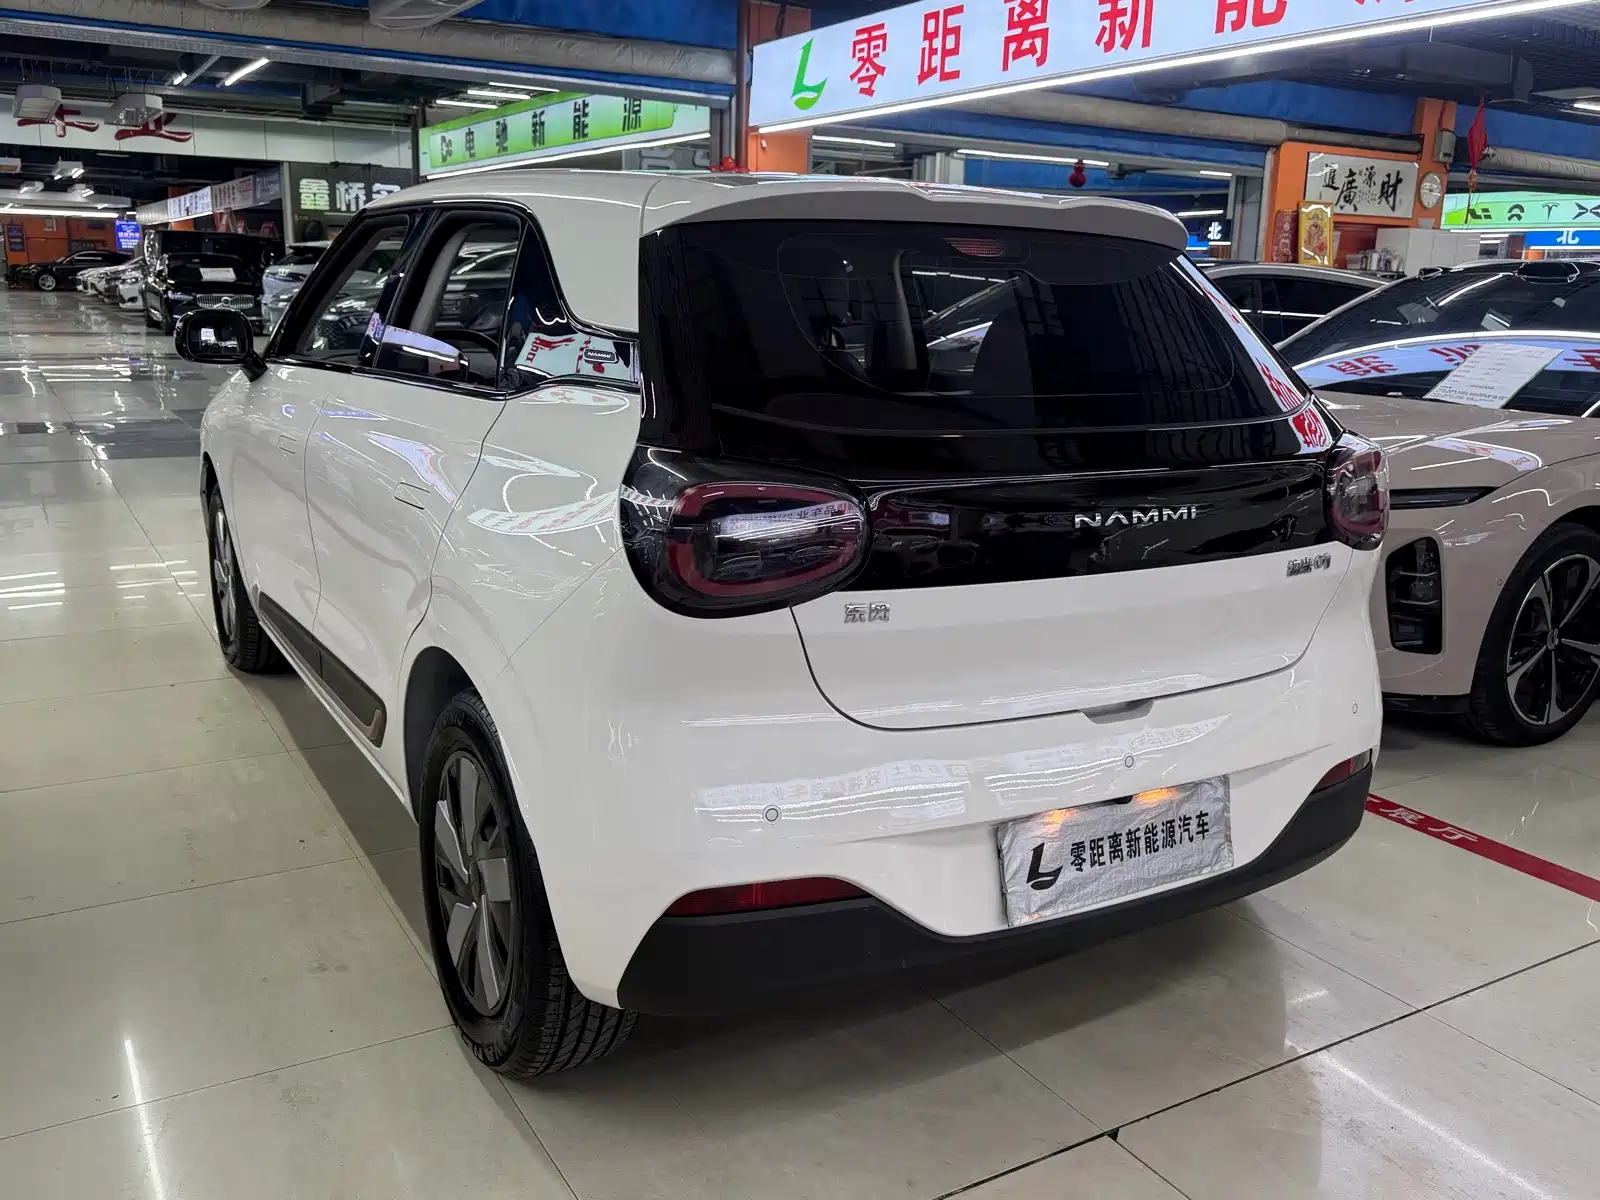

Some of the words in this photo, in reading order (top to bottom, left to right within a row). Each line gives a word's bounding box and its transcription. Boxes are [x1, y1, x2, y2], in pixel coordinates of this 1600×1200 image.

[849, 0, 1413, 97] 零距离新
[464, 97, 642, 158] 电驰新能源
[1074, 505, 1197, 529] NAMMI
[844, 601, 891, 624] 东风
[1070, 810, 1210, 873] 零距离新能源汽车
